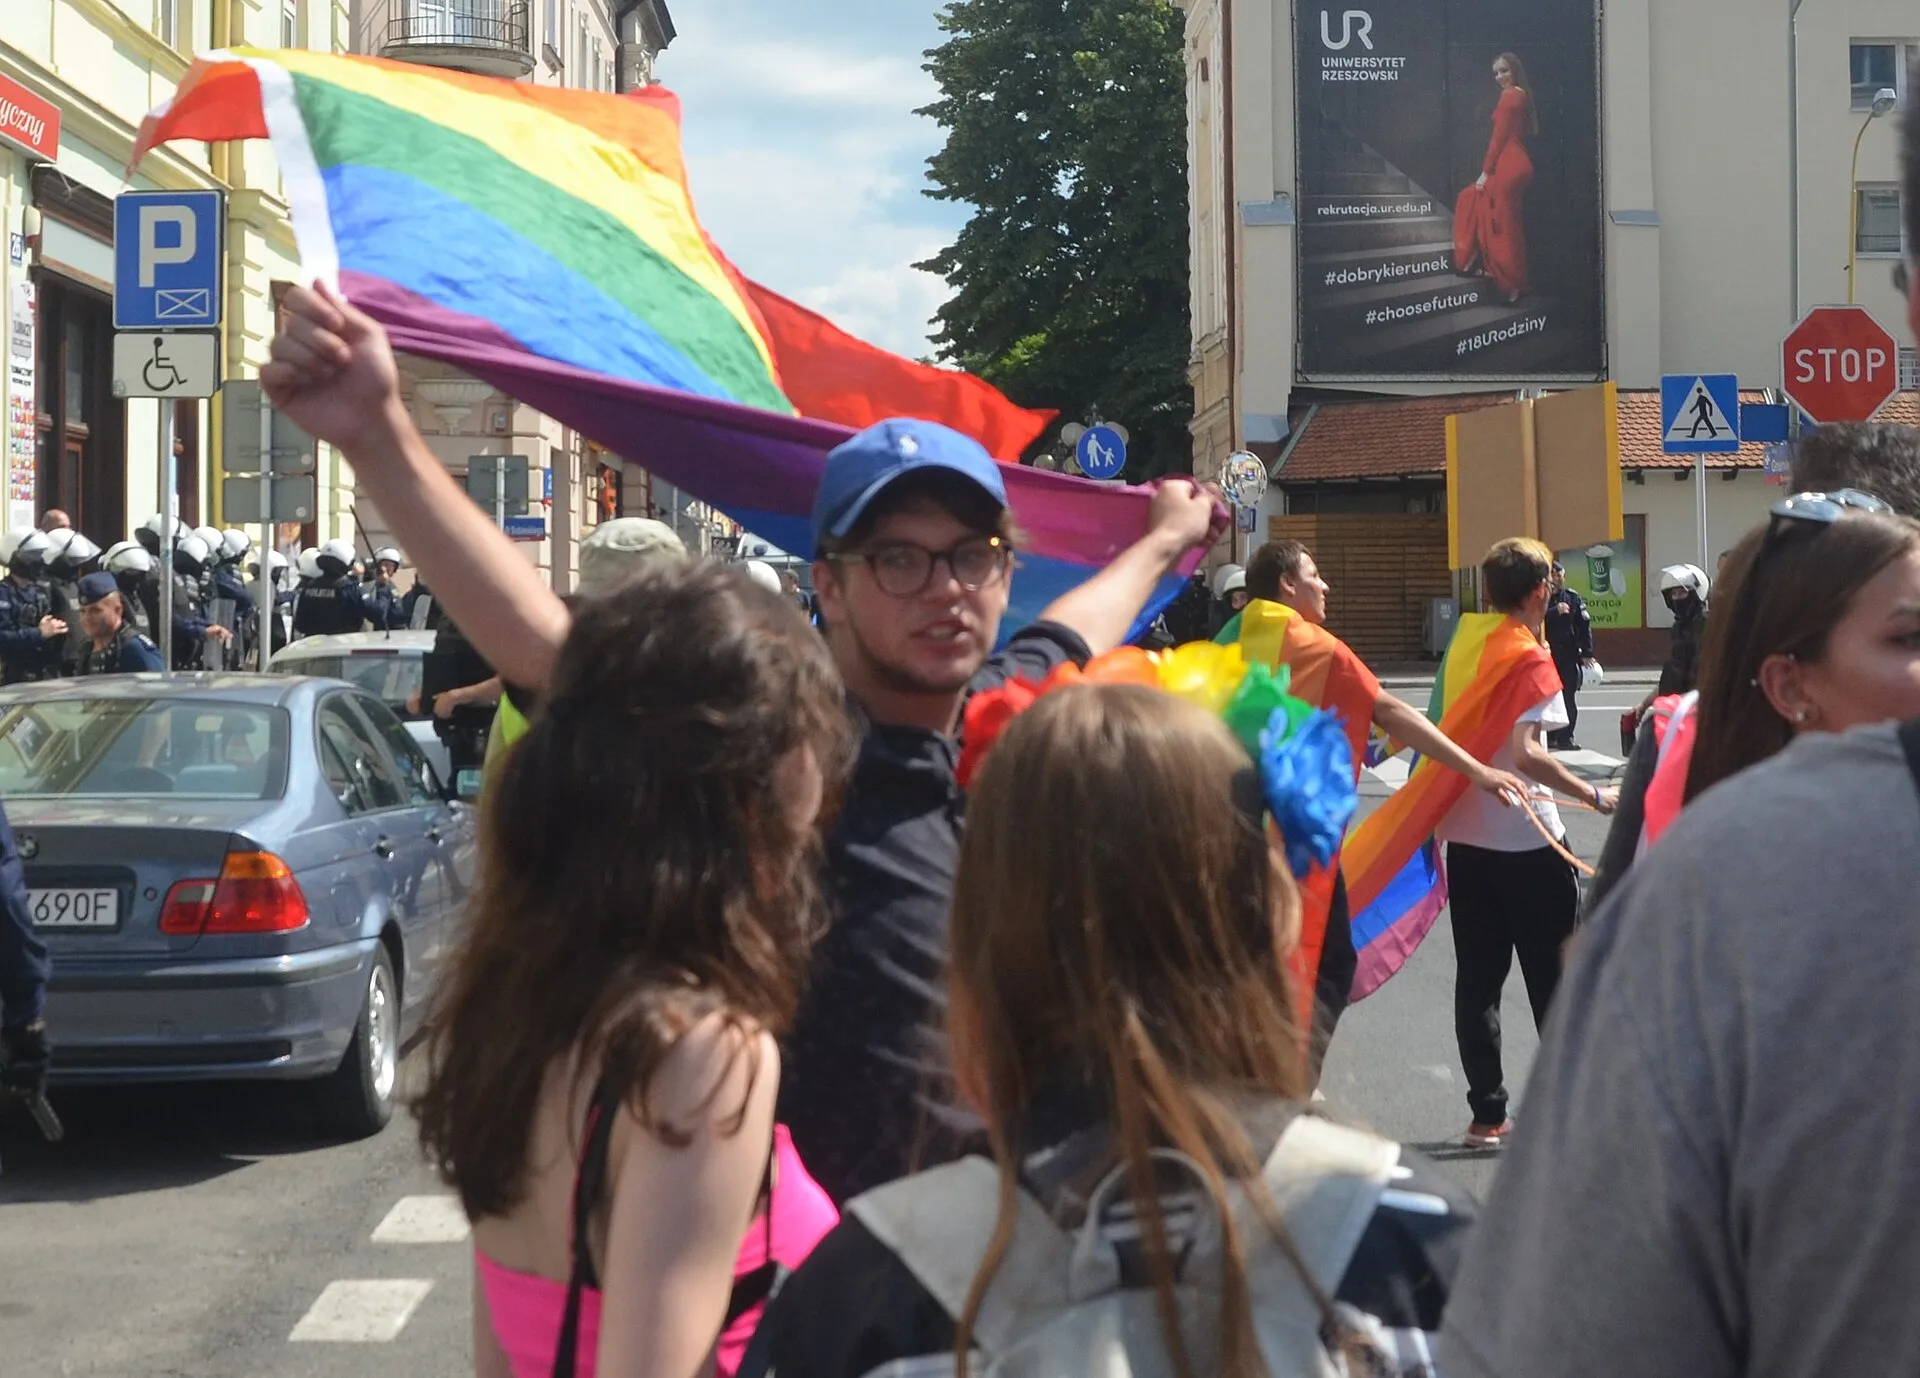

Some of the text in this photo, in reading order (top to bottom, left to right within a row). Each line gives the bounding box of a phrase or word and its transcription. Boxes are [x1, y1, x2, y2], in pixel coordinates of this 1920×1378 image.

[1321, 10, 1373, 50] UR
[1321, 57, 1406, 68] UNIWERSYTET
[1322, 70, 1398, 81] RZESZOWSKI
[0, 97, 45, 145] yczny
[1317, 202, 1431, 216] rekrutacja.ur.edu.pl
[138, 205, 197, 288] P
[1325, 256, 1449, 286] #dobrykierunek
[1365, 292, 1478, 324] #choosefuture
[1456, 316, 1547, 355] #18URodziny
[1795, 348, 1886, 383] STOP
[1590, 612, 1619, 623] awa?
[27, 892, 111, 922] 690F
